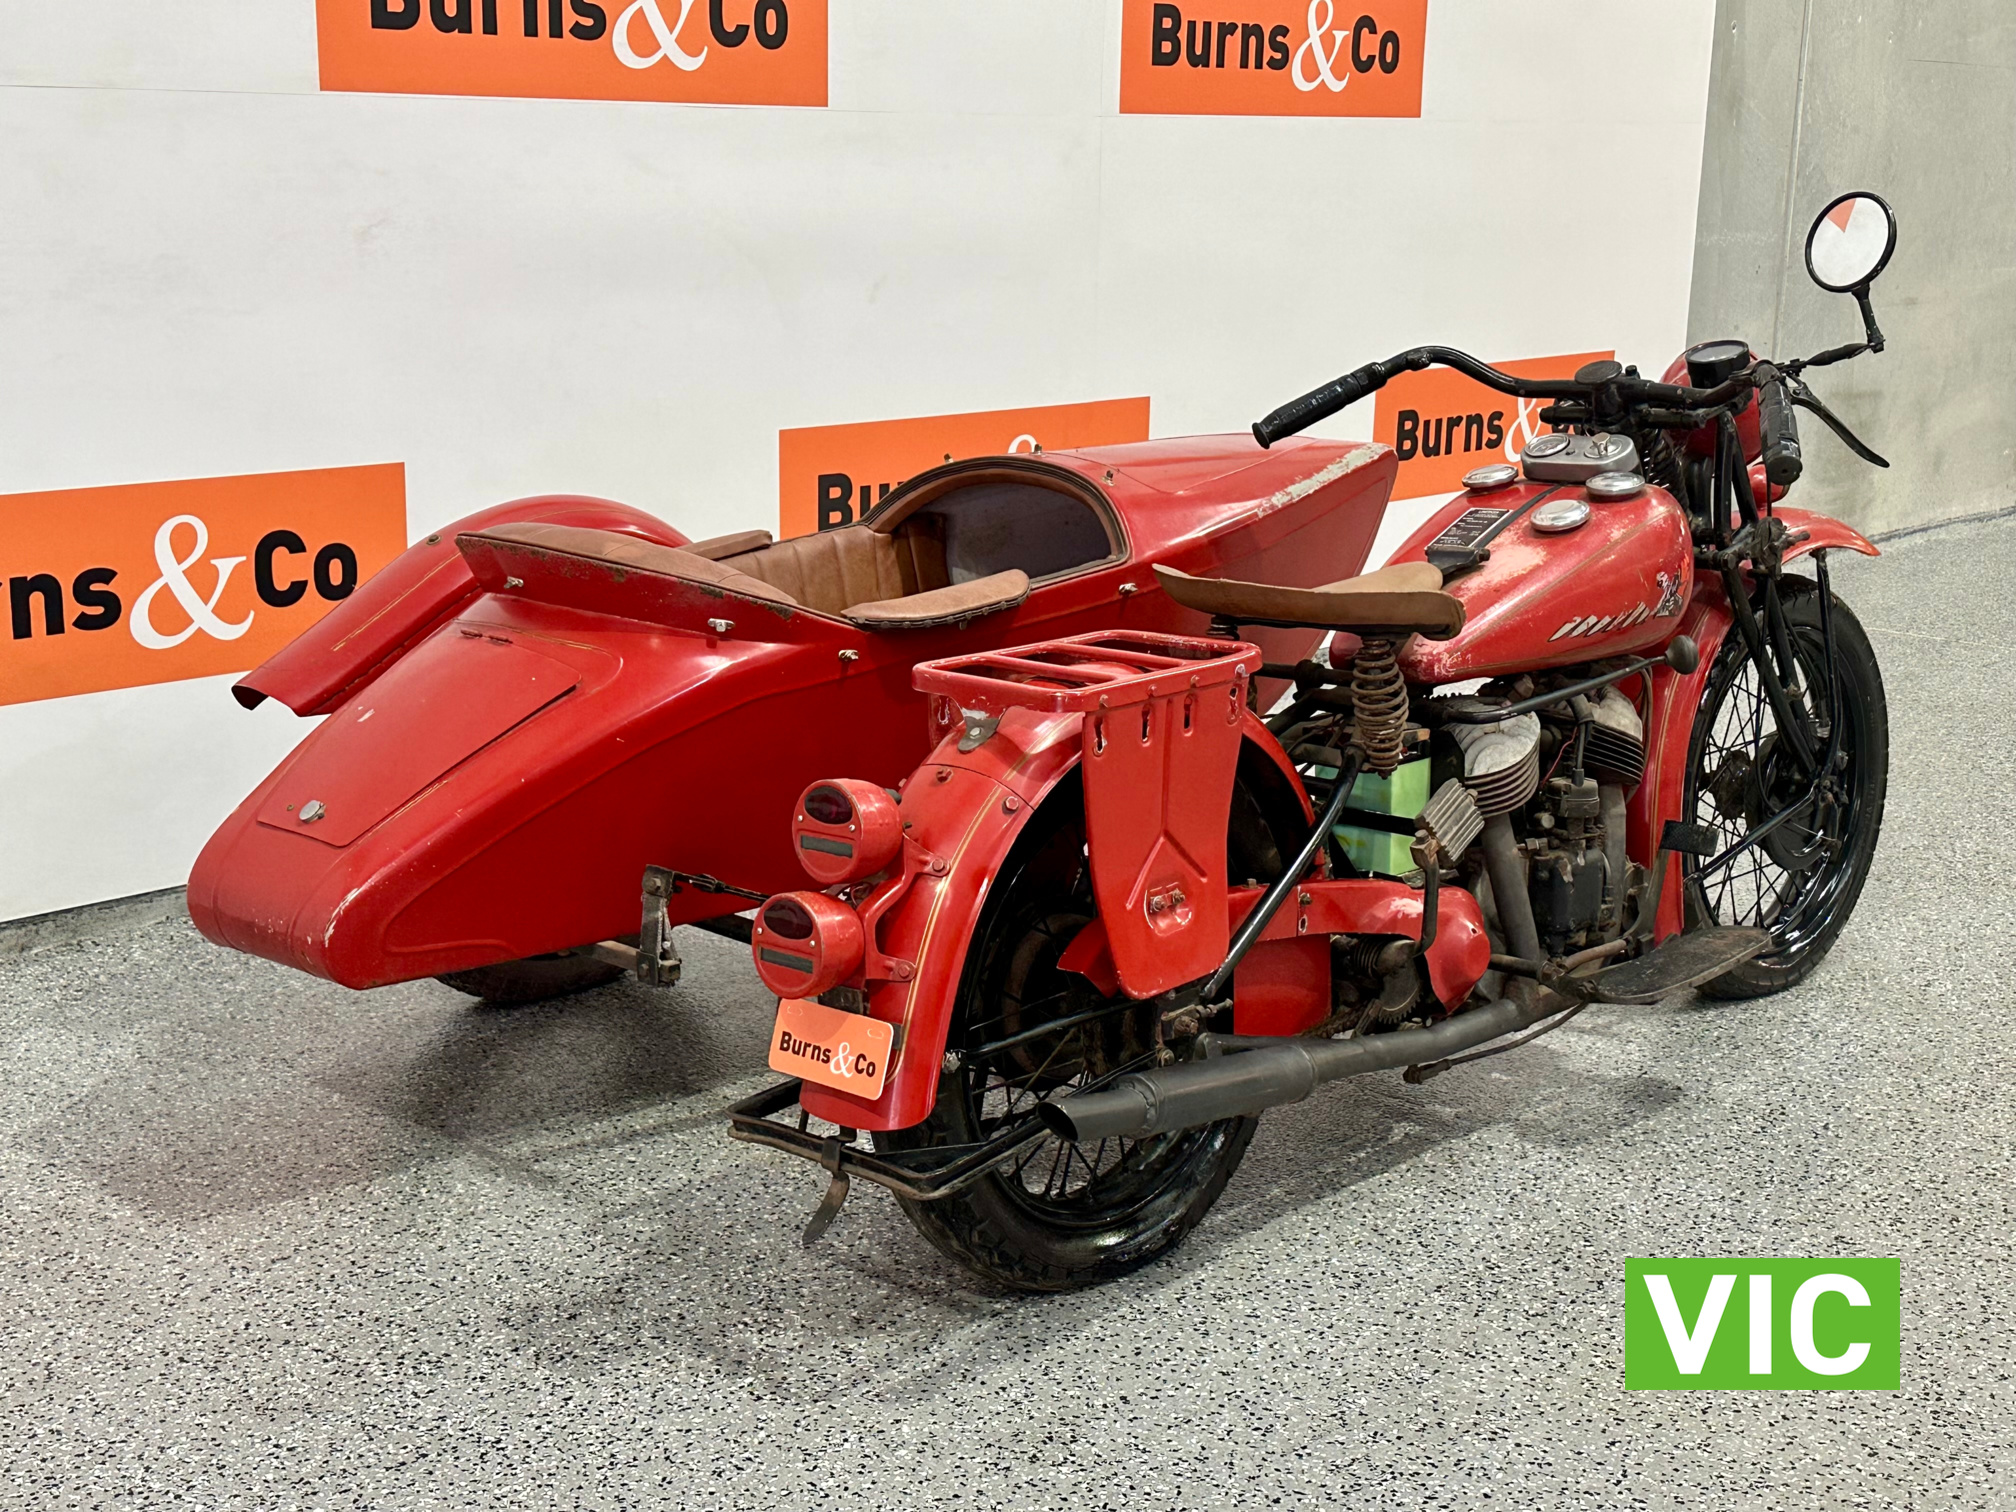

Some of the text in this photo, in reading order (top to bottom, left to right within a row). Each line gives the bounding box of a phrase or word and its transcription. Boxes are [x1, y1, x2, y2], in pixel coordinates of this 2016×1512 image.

[1151, 0, 1400, 92] Burns&Co
[1397, 397, 1586, 463] Burns&
[0, 514, 358, 650] ns&Co
[779, 1030, 876, 1078] Burns&Co
